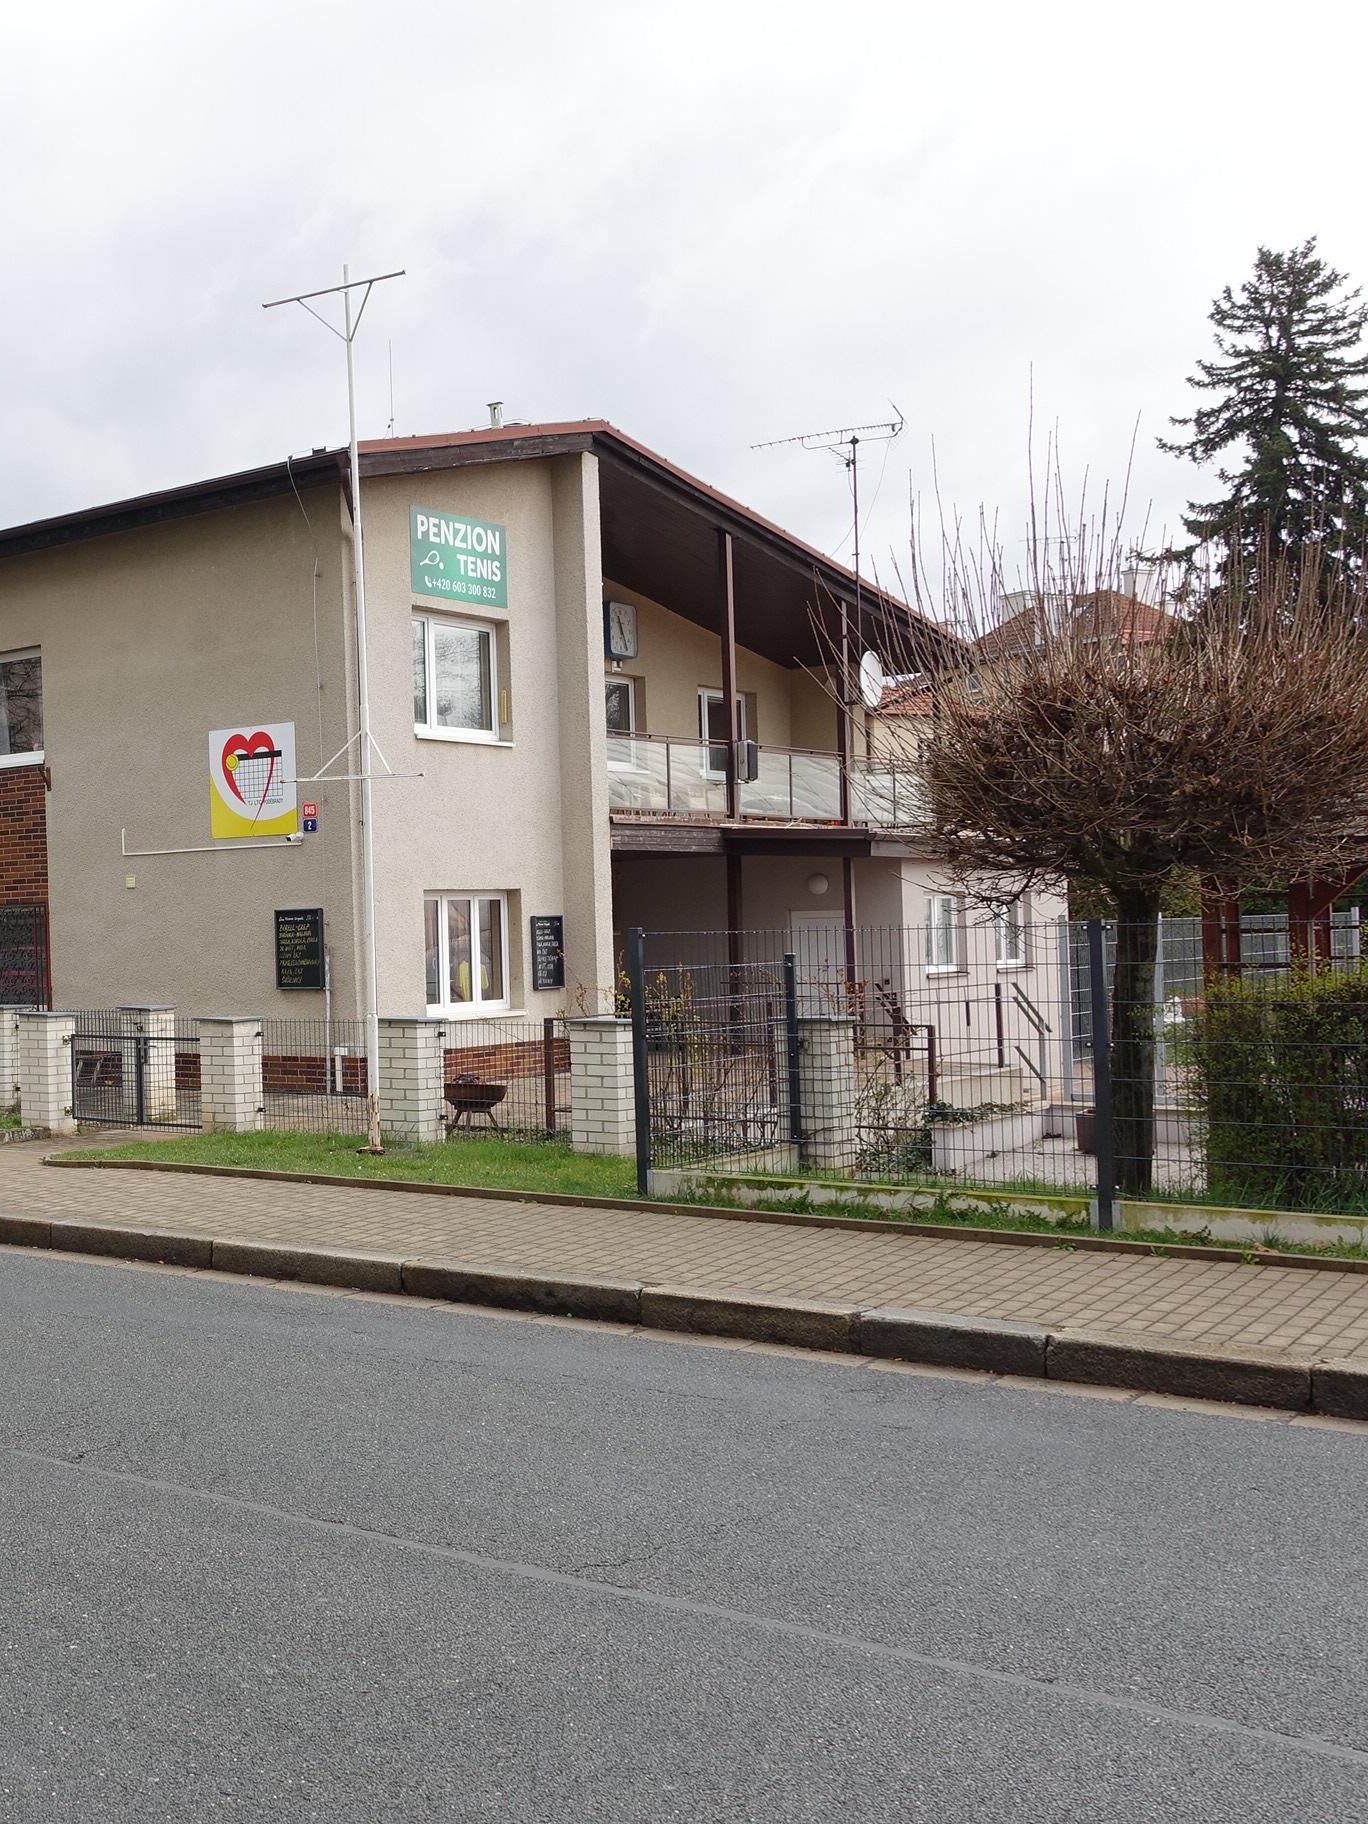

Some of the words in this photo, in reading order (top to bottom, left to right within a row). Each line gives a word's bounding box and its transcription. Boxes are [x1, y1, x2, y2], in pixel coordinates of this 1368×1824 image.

[416, 514, 501, 555] PENZION
[456, 553, 501, 582] TENIS
[432, 578, 451, 590] +420
[452, 580, 466, 593] 603
[468, 583, 481, 596] 300
[483, 586, 496, 598] 832
[304, 805, 315, 816] 845
[307, 821, 312, 830] 2
